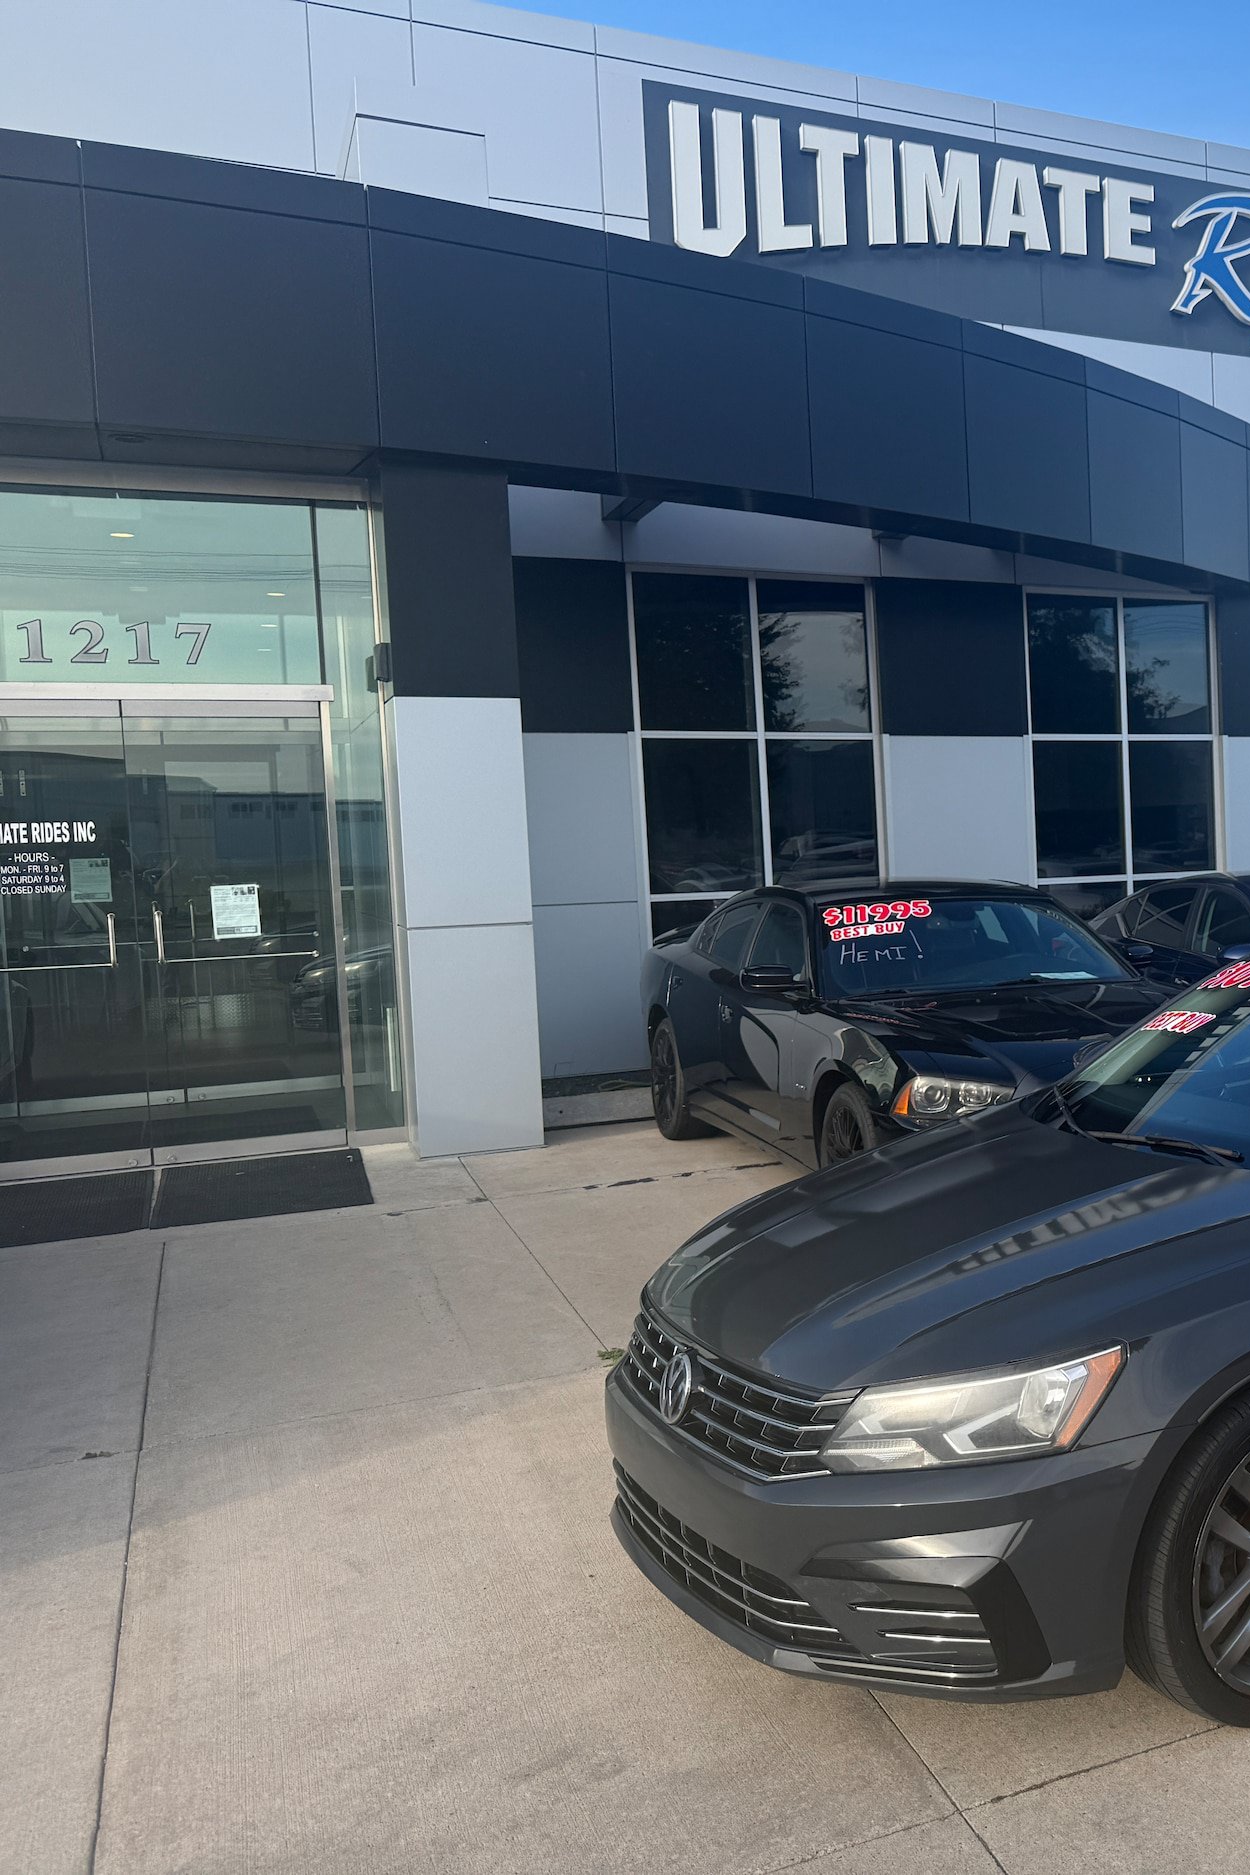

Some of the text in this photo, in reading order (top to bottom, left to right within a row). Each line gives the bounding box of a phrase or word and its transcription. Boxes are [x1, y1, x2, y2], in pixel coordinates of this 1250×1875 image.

[667, 99, 1156, 266] ULTIMATE
[16, 619, 212, 665] 1217
[31, 821, 70, 843] RIDES
[73, 821, 96, 842] INC
[14, 852, 49, 862] HOURS
[44, 865, 49, 873] 9
[51, 865, 58, 873] to
[59, 864, 64, 872] 7
[1, 874, 64, 884] SATURDAY 9 to 4
[0, 885, 67, 895] CLOSED SUNDAY
[823, 900, 932, 926] $11995
[830, 921, 905, 941] BEST BUY
